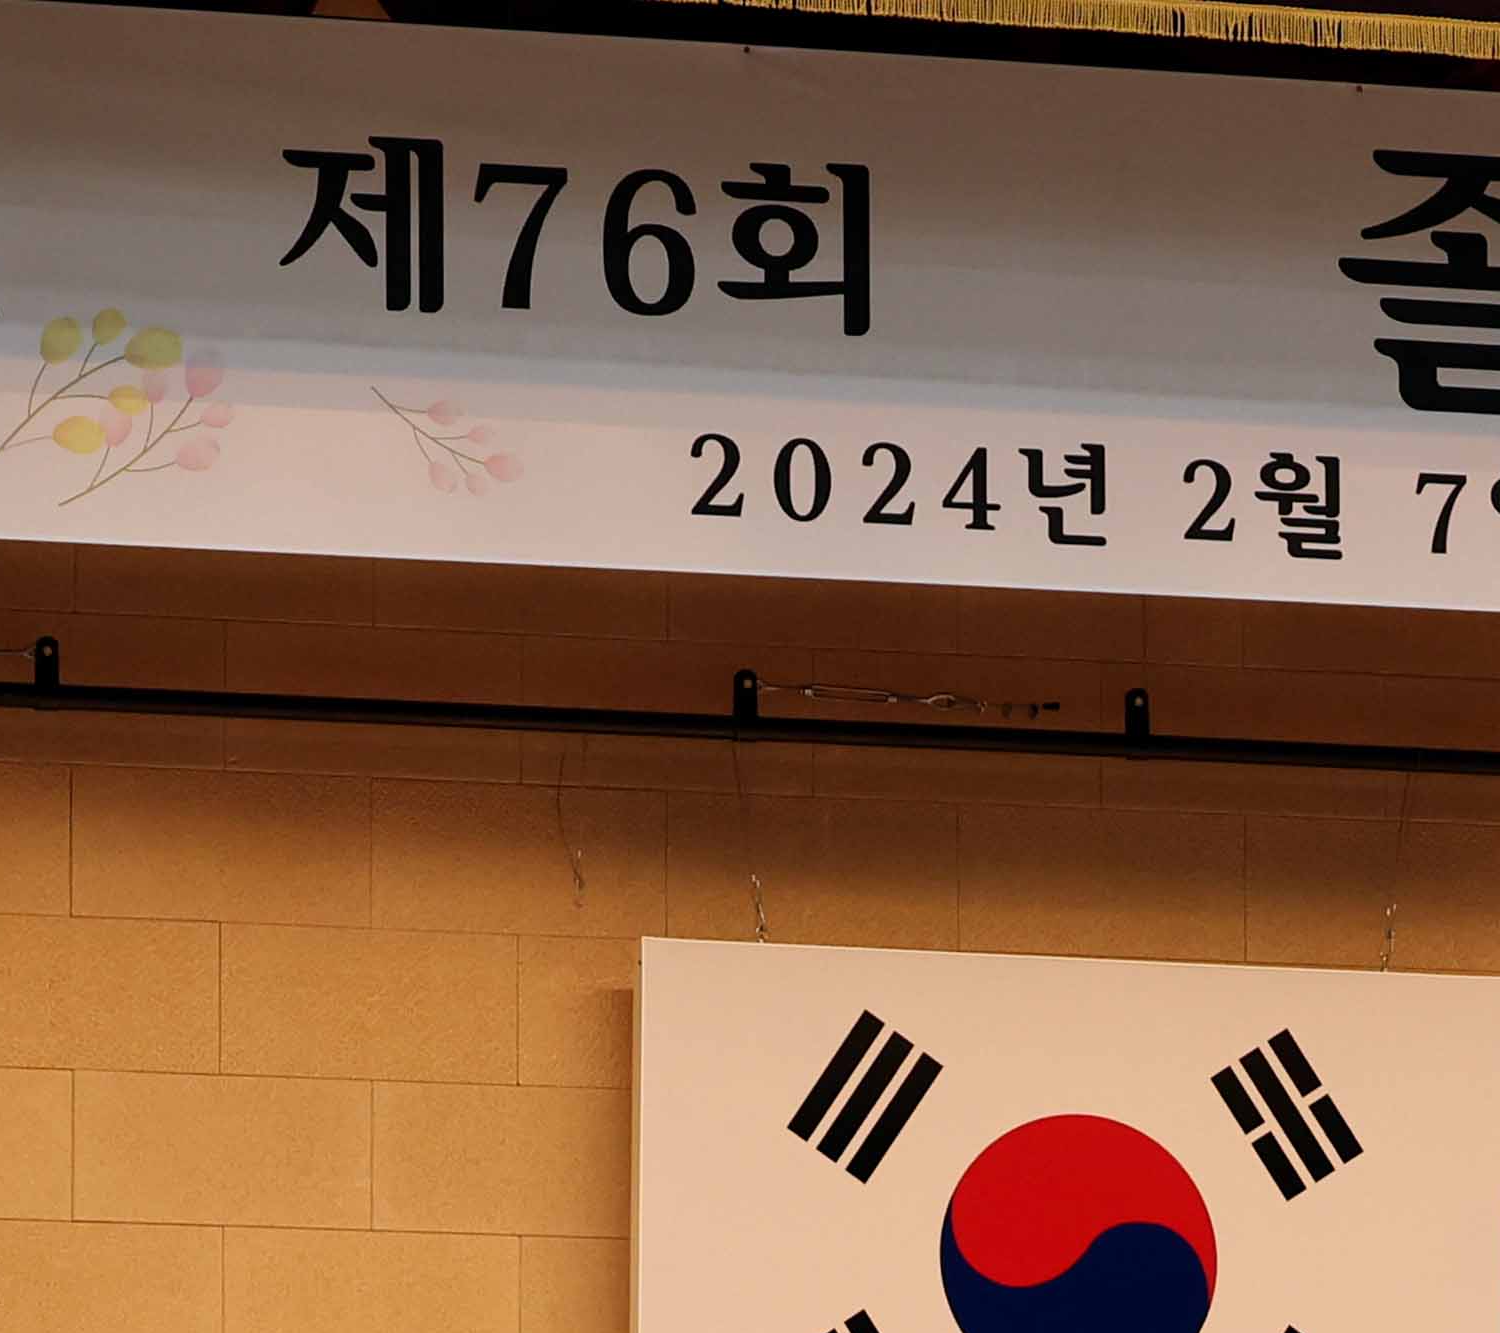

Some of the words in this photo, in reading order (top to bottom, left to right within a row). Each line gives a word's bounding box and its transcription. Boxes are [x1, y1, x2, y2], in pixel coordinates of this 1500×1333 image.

[277, 134, 872, 338] 제76회
[689, 432, 1108, 548] 2024년
[1182, 451, 1344, 561] 2월
